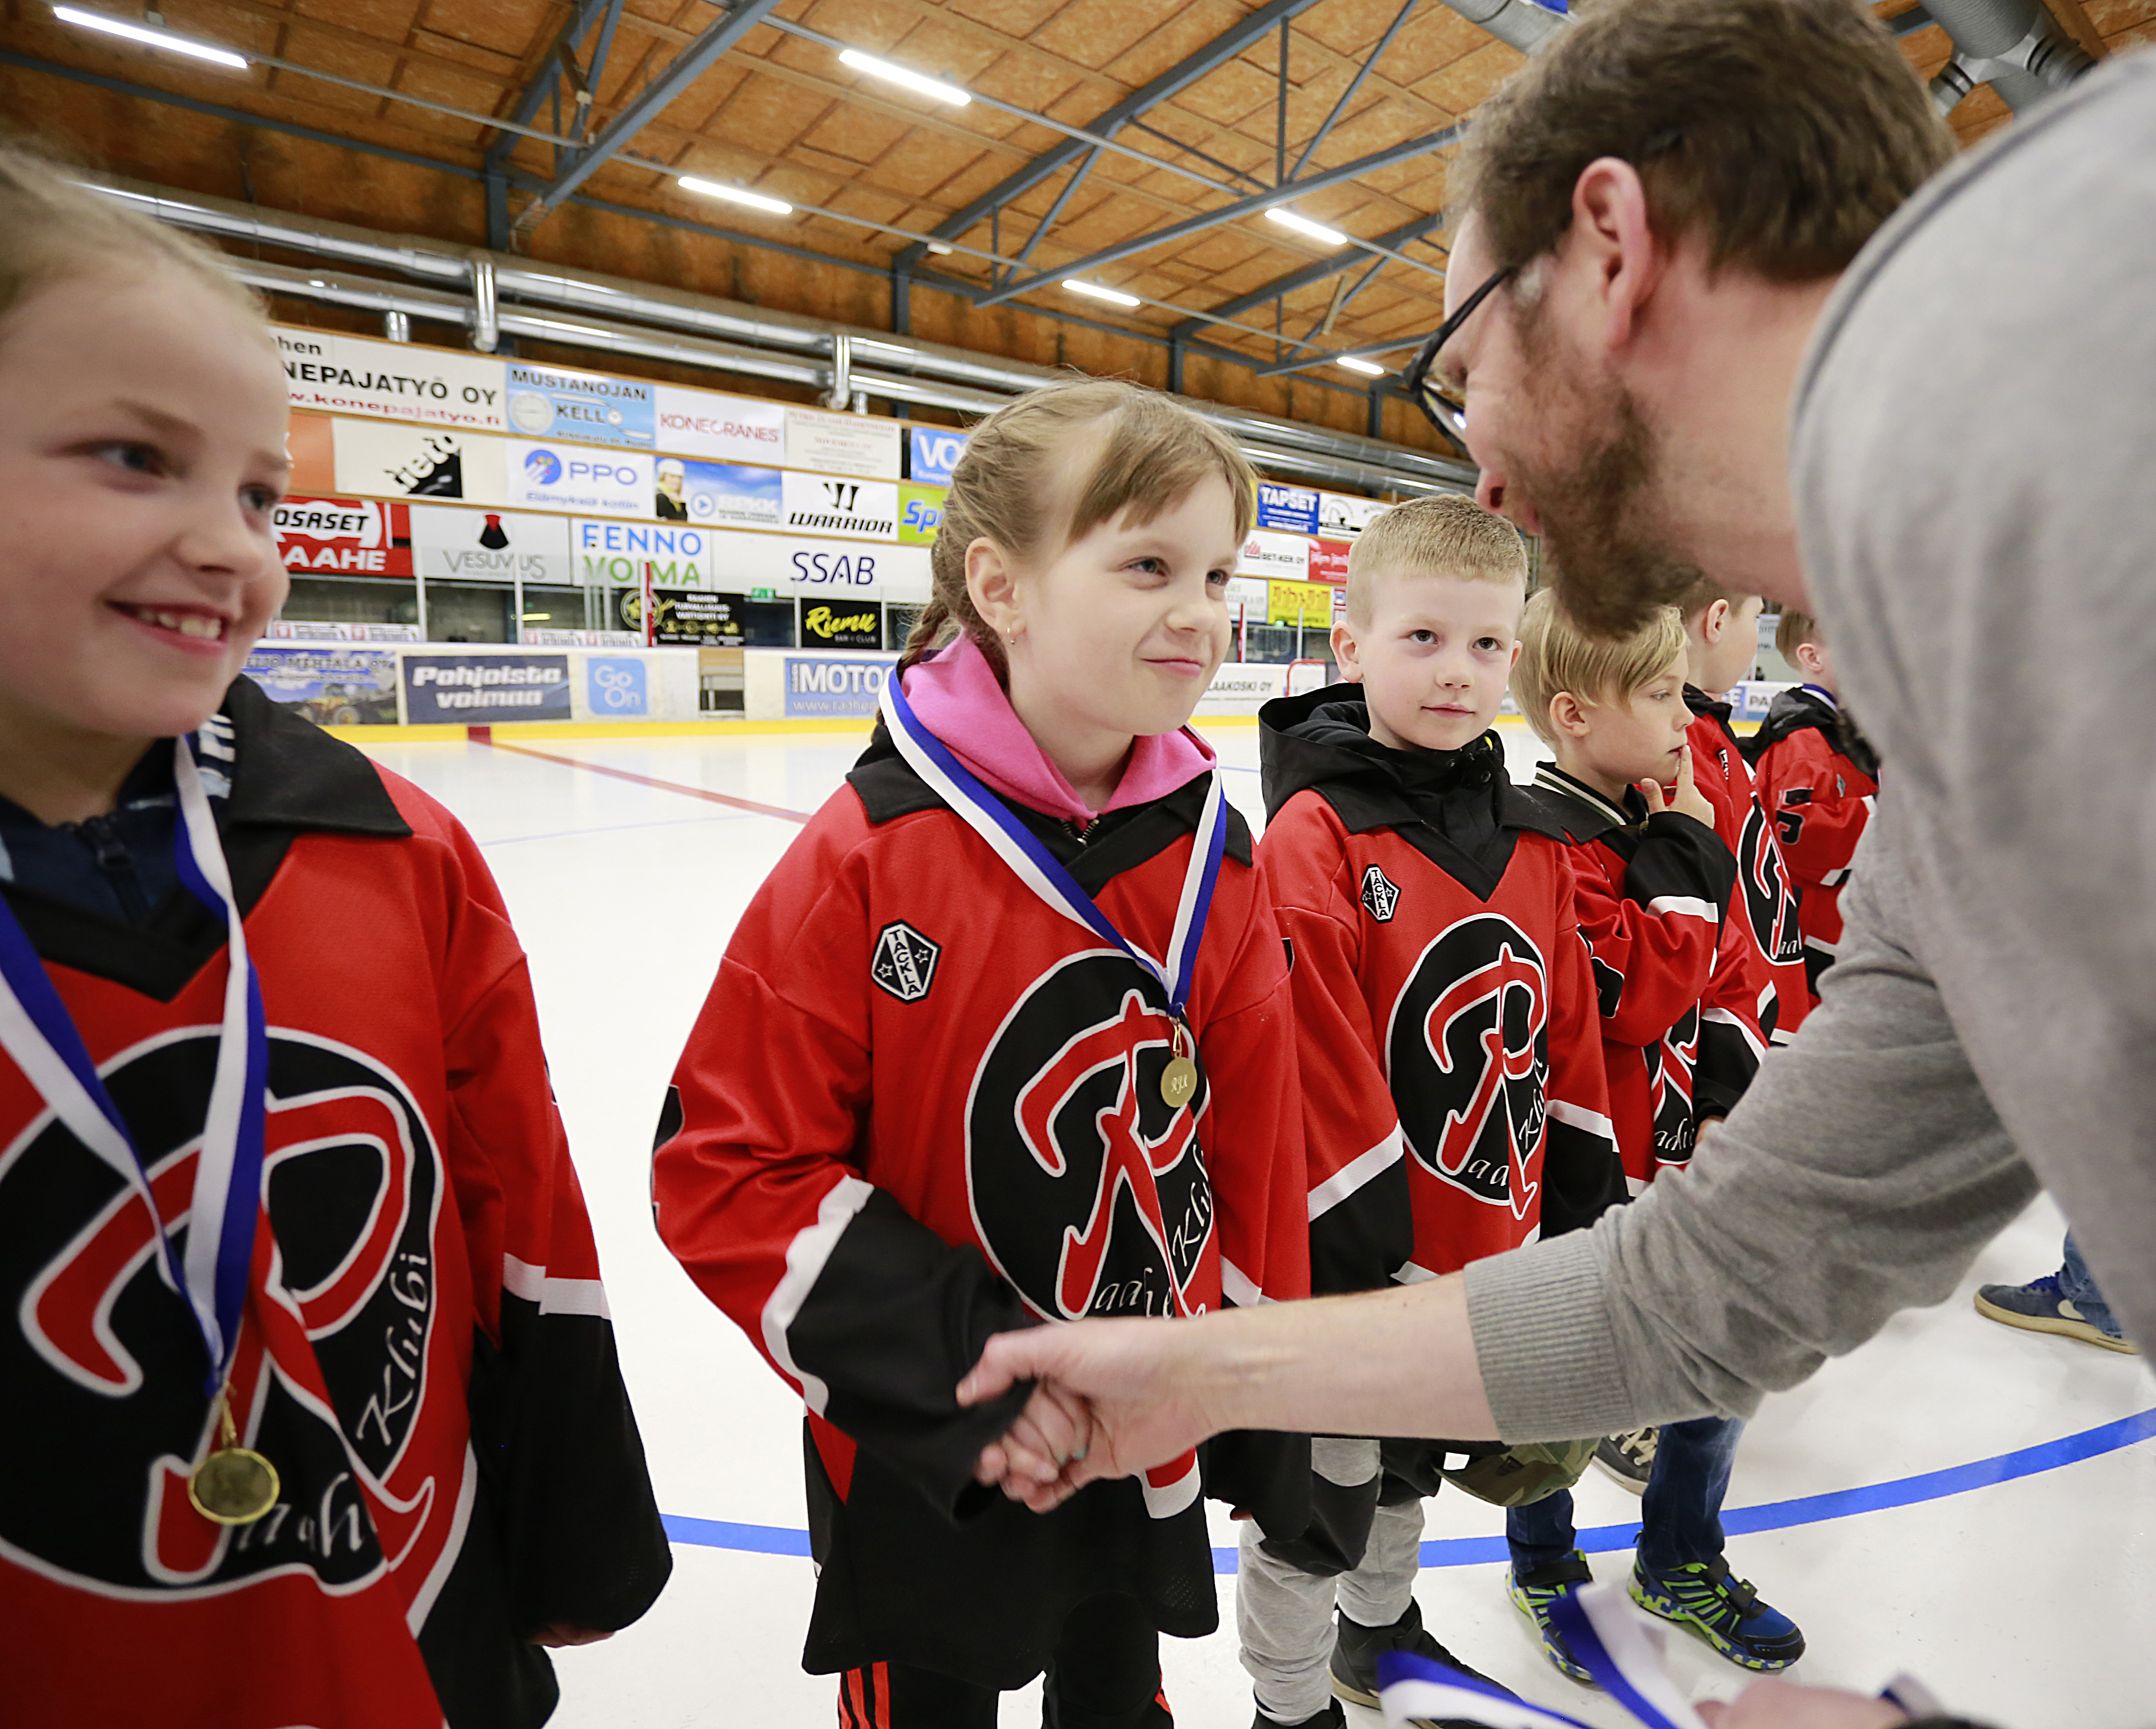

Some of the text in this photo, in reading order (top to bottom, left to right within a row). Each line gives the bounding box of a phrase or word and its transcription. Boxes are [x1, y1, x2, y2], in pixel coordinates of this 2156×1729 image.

[461, 387, 497, 405] OY
[512, 370, 648, 402] MUSTANOJAN
[660, 413, 779, 442] KONECRANES
[919, 435, 967, 471] VO
[569, 462, 637, 485] PPO
[1260, 486, 1317, 512] TAPSET
[274, 508, 370, 532] OSASET
[788, 511, 893, 534] WARRIOR
[902, 500, 944, 534] Sp
[583, 524, 701, 555] FENNO
[285, 545, 386, 571] AAHE
[443, 550, 547, 580] VESUVUS
[790, 552, 875, 585] SSAB
[412, 665, 563, 688] Pohjoista
[594, 664, 633, 688] Go
[799, 663, 894, 695] MOTO
[436, 689, 544, 709] voimaa
[604, 686, 642, 708] On
[1370, 869, 1389, 918] TACKLA
[888, 929, 921, 995] TACKLA
[356, 1253, 428, 1446] Klubi
